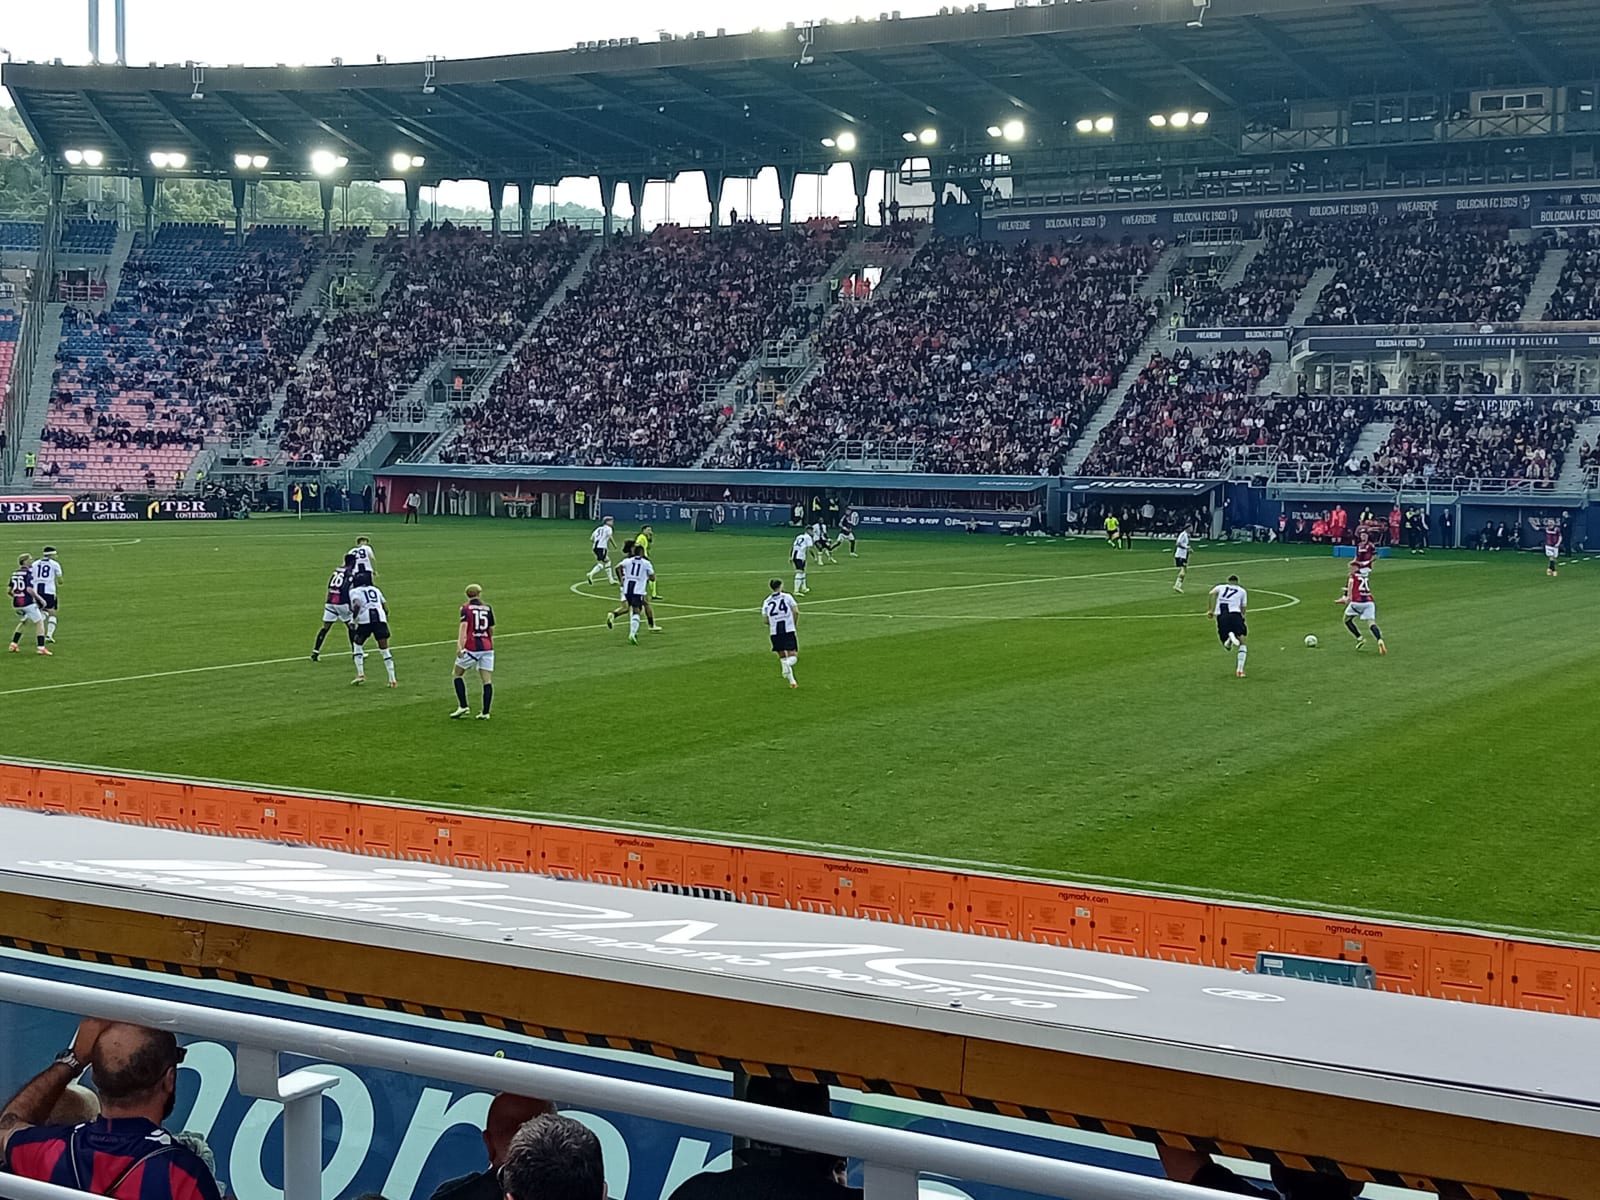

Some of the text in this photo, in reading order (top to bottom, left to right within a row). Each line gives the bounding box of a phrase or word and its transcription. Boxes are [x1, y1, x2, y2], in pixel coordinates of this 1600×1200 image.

[1457, 196, 1518, 210] BOLOGNA FC 1909
[1173, 211, 1200, 222] BOLOGNA
[1202, 210, 1210, 222] FC
[1310, 204, 1366, 216] BOLOGNA FC 1909
[1540, 210, 1574, 222] BOLOGNA
[1576, 209, 1586, 220] FC
[1045, 219, 1072, 228] BOLOGNA
[1072, 218, 1080, 228] FC
[1453, 336, 1559, 346] STADIO RENATO DALL'ARA
[76, 501, 126, 512] TER
[160, 501, 206, 512] TER
[37, 564, 50, 578] 18
[631, 562, 641, 577] 11
[12, 575, 26, 591] 56
[330, 572, 344, 588] 26
[364, 589, 378, 603] 19
[1222, 586, 1238, 598] 17
[768, 600, 788, 617] 24
[472, 610, 489, 630] 15
[425, 816, 462, 826] ngmadv.com
[614, 838, 655, 849] ngmadv.com
[823, 862, 869, 874] ngmadv.com
[1058, 892, 1109, 904] ngmadv.com
[379, 912, 502, 926] per
[1325, 924, 1383, 938] ngmadv.com
